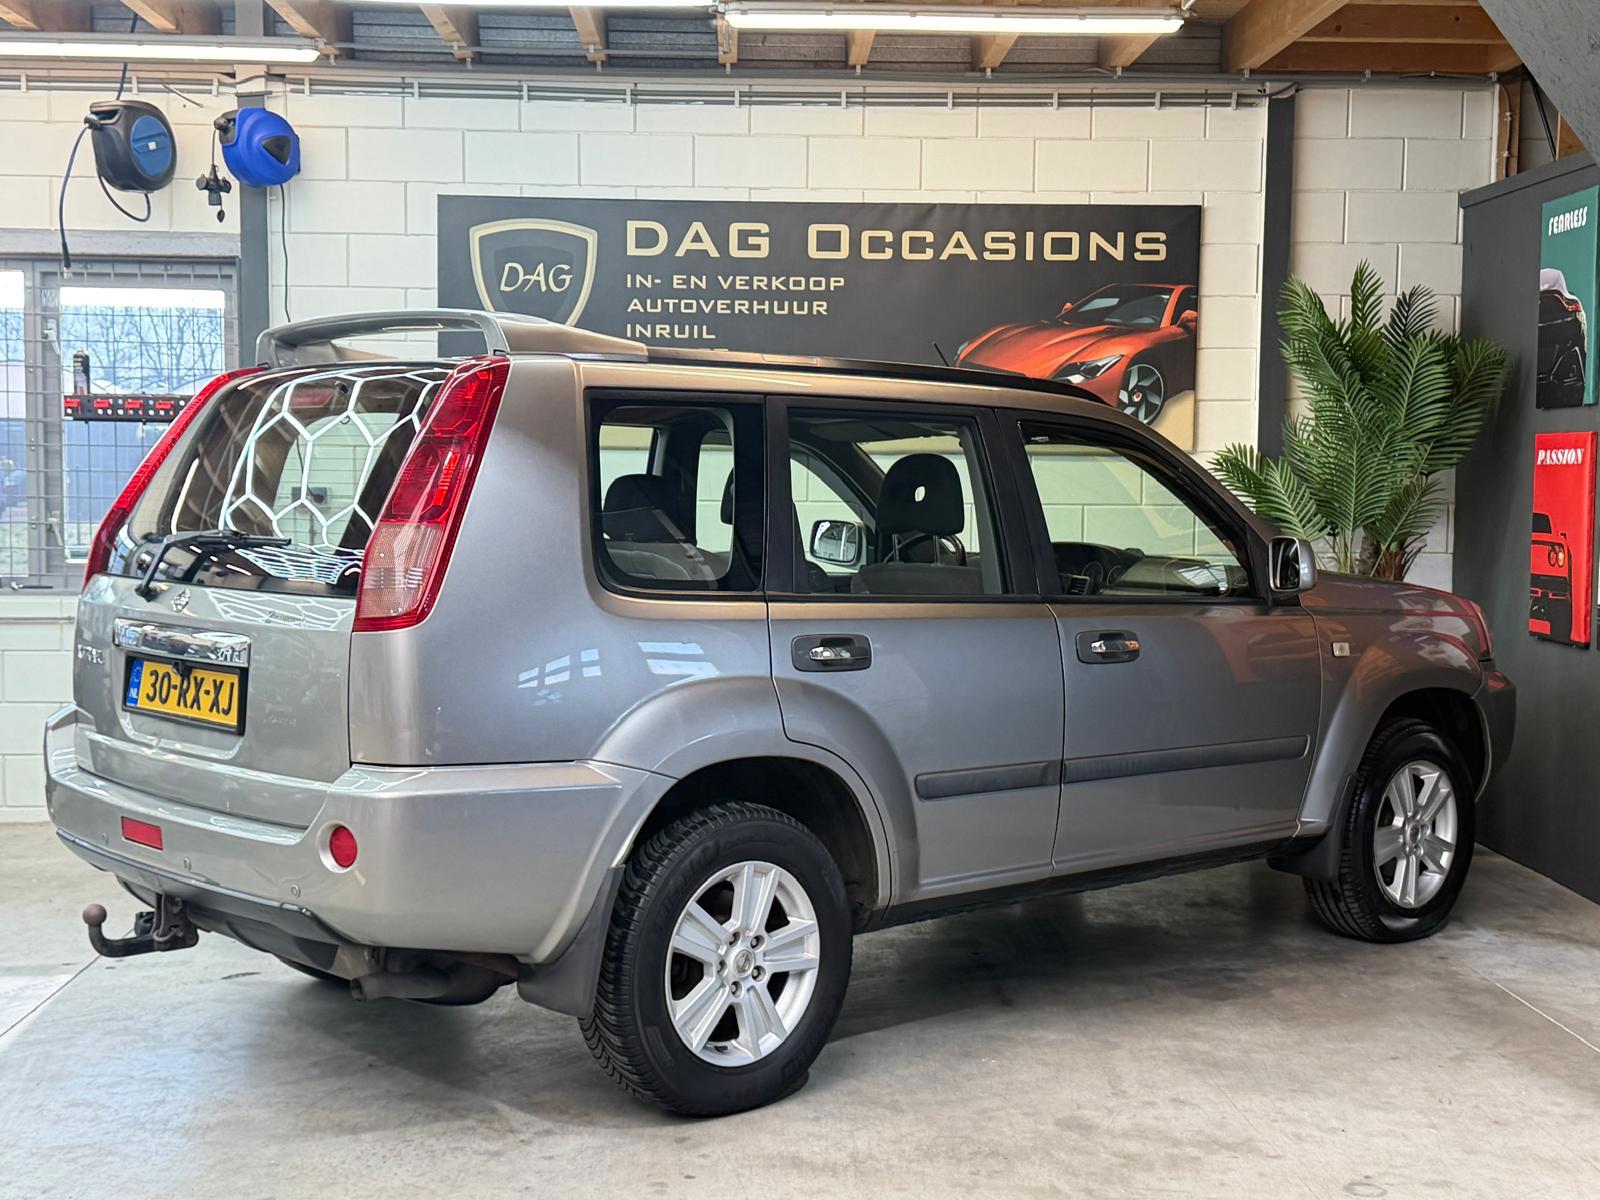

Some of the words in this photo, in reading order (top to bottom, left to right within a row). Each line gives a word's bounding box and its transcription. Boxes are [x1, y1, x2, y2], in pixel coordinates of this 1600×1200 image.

[1548, 206, 1588, 236] FEARLESS
[626, 220, 770, 259] DAG
[807, 223, 1167, 262] OCCASIONS
[499, 261, 573, 293] DAG
[626, 273, 662, 289] IN-
[673, 274, 707, 290] EN
[717, 275, 845, 292] VERKOOP
[626, 299, 829, 316] AUTOVERHUUR
[626, 322, 716, 340] INRUIL
[1537, 448, 1584, 465] PASSION
[128, 687, 138, 699] NL
[146, 669, 235, 716] 30-RX-XJ
